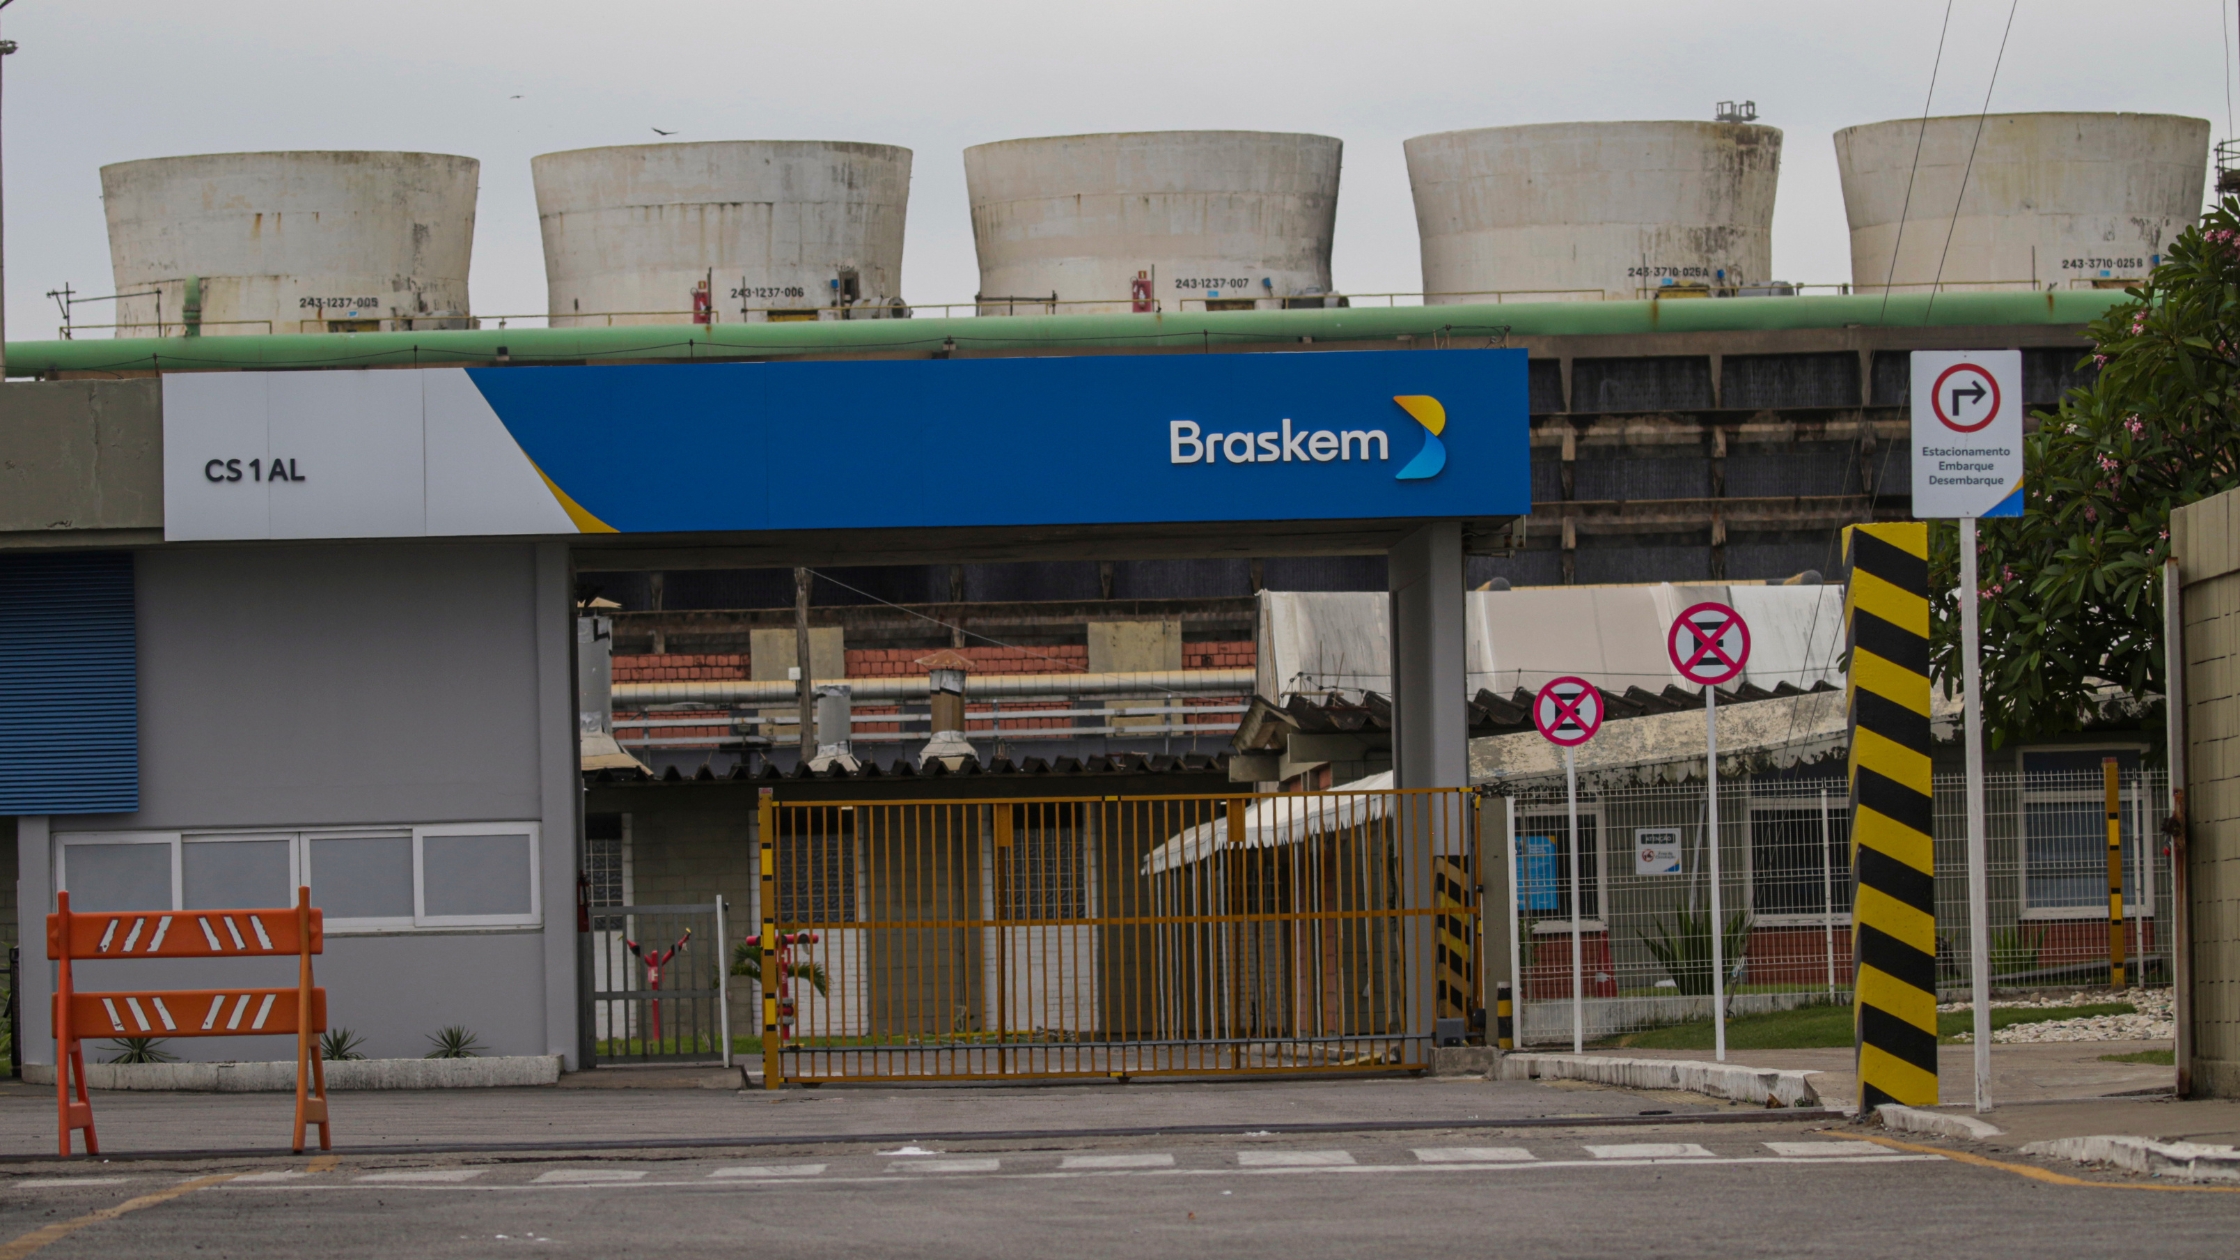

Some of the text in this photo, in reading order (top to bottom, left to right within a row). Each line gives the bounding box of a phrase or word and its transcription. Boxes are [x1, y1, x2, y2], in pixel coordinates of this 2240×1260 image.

[1175, 278, 1249, 289] 243-1237-007
[731, 287, 804, 298] 243-1237-006
[300, 297, 378, 308] 243-1237-005
[1170, 418, 1388, 463] Braskem
[1922, 447, 2010, 456] Estacionamento
[205, 458, 305, 482] CS 1 AL
[1939, 461, 1994, 472] Embarque
[1929, 475, 2004, 487] Desembarque
